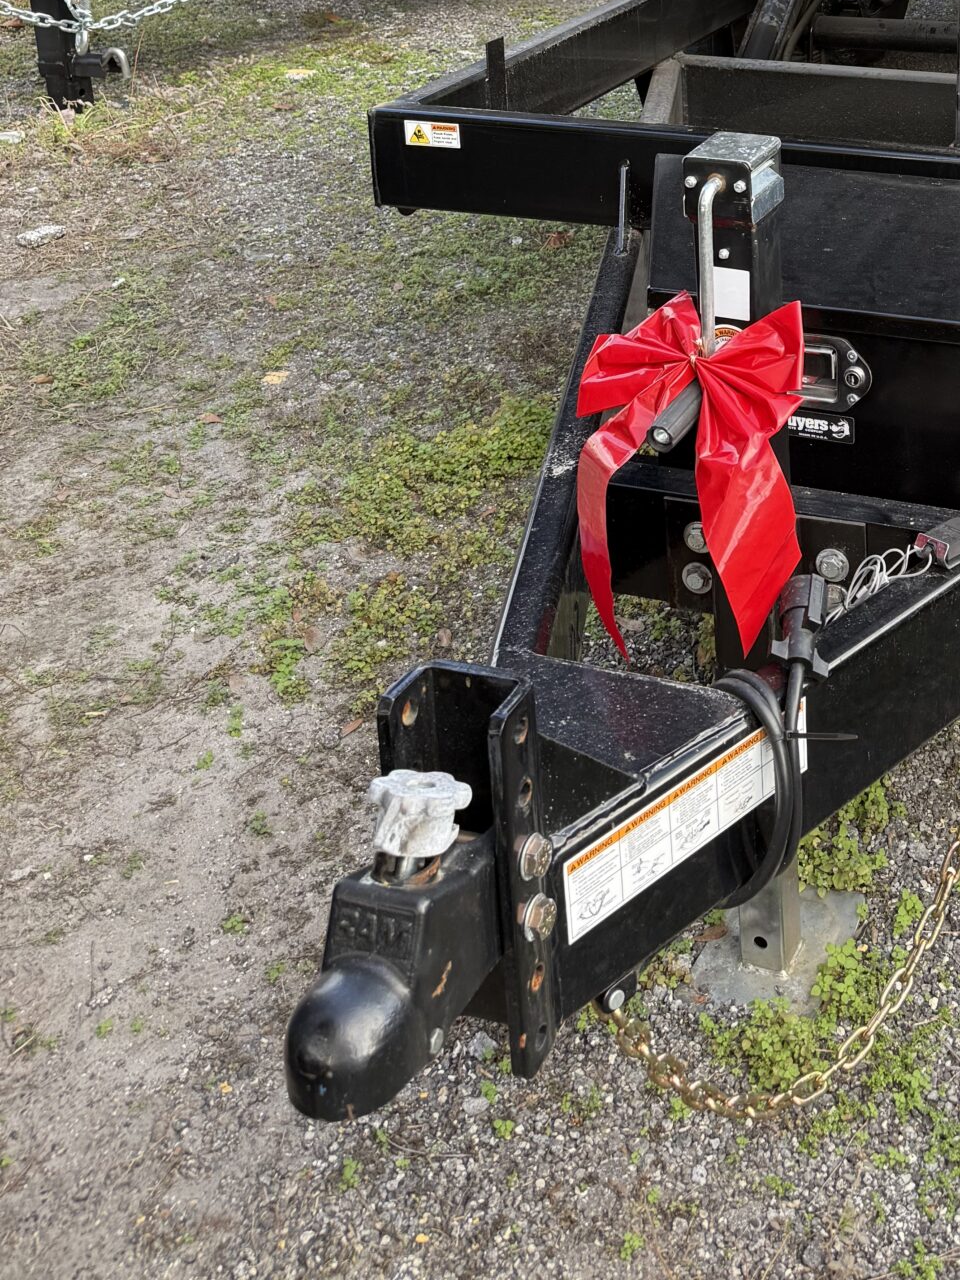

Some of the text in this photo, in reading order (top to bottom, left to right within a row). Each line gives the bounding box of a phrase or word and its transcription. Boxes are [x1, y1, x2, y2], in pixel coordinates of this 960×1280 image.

[727, 736, 759, 761] WARNING
[680, 767, 712, 794] WARNING
[631, 801, 666, 828] WARNING
[576, 837, 613, 866] WARNING
